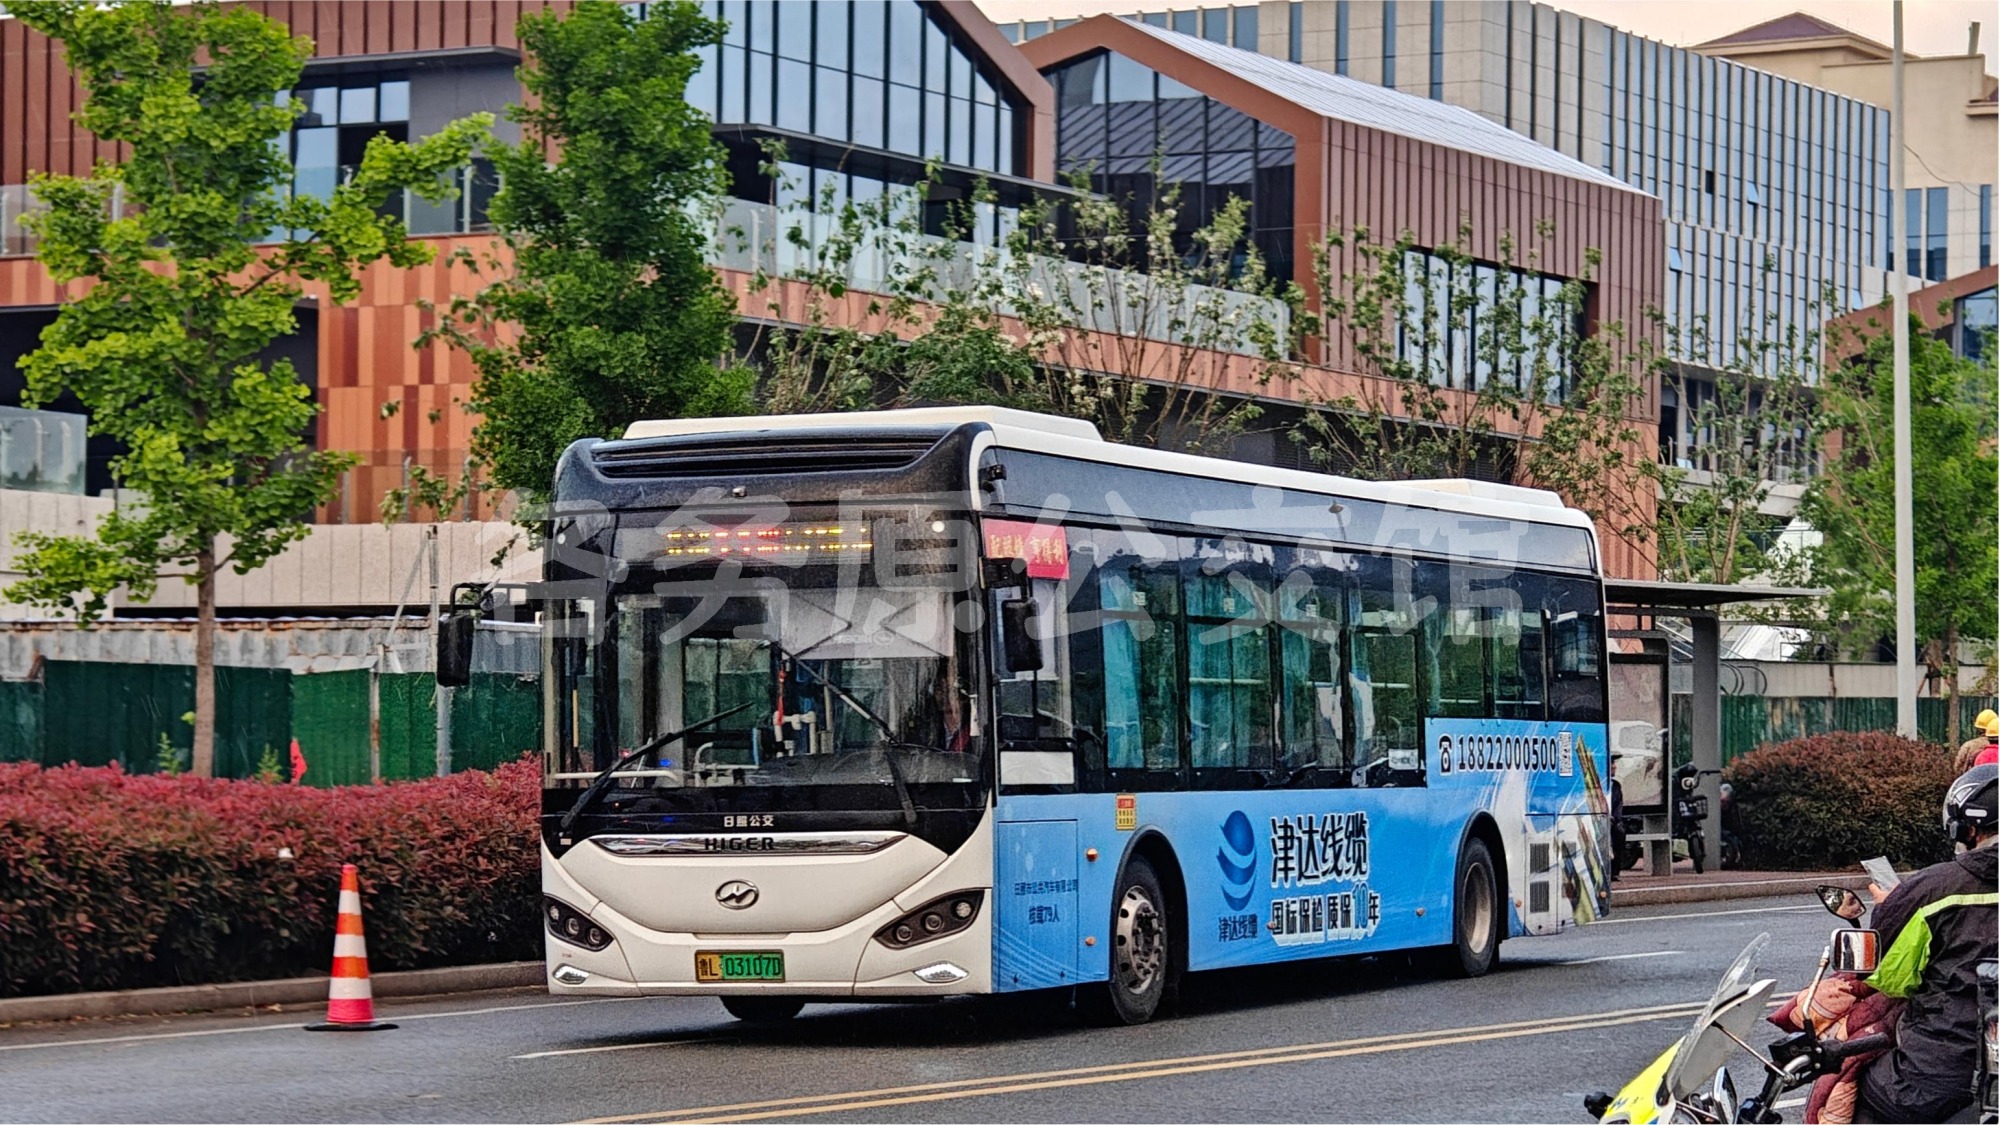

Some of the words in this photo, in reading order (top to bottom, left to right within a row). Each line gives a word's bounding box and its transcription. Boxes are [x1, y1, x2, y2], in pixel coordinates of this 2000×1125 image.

[1458, 735, 1556, 770] 18822000500
[723, 814, 775, 828] 日照公交
[704, 837, 774, 850] HIGER
[1270, 811, 1368, 885] 津达线缆
